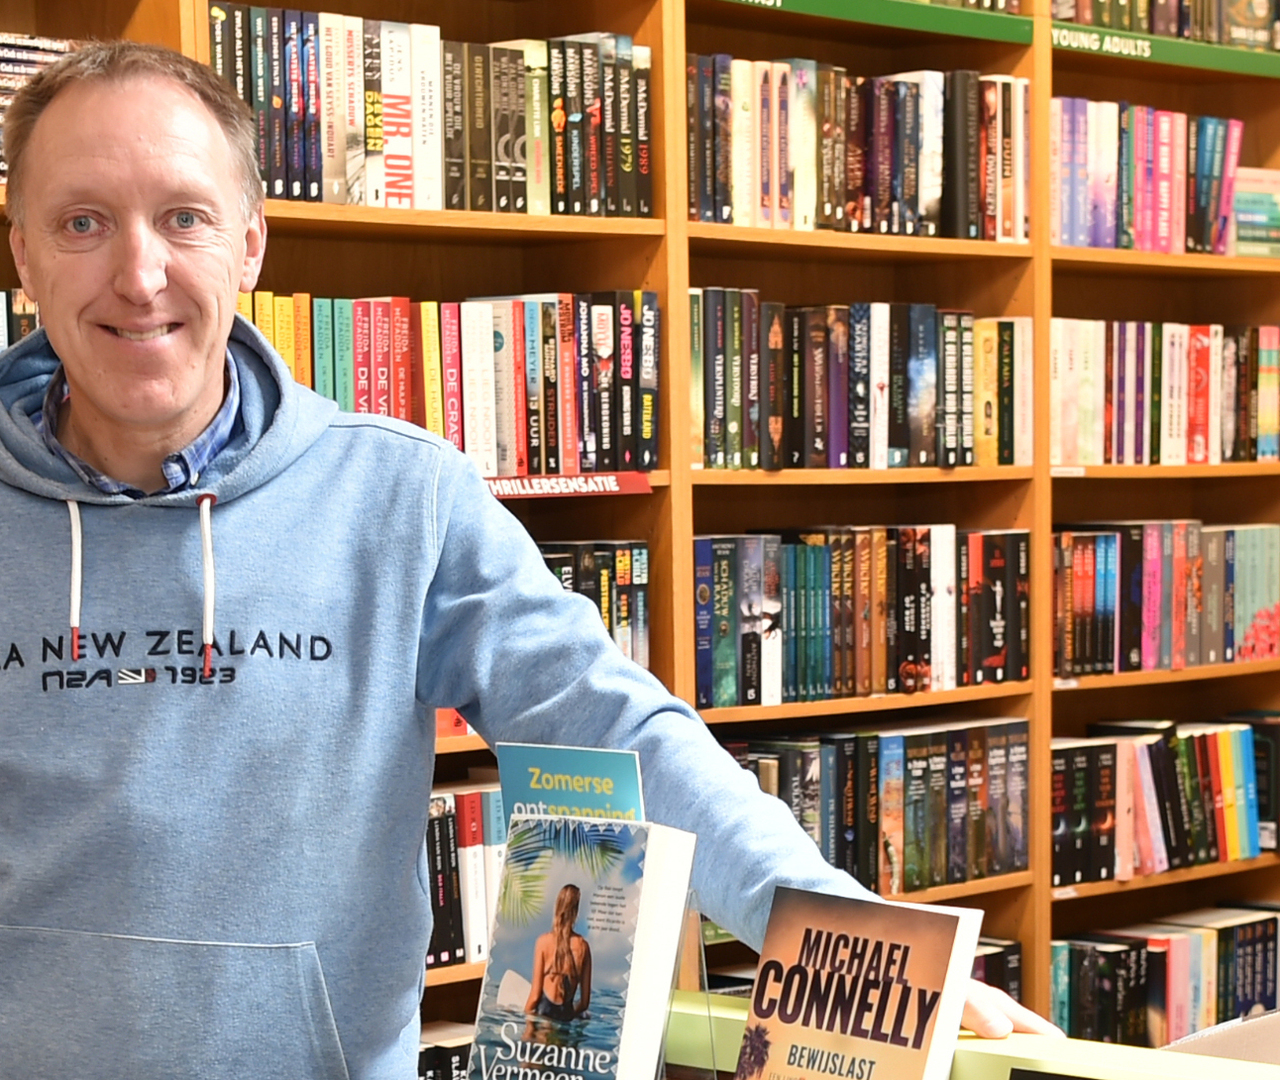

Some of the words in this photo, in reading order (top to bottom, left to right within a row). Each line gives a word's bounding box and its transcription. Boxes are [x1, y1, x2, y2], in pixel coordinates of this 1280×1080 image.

[1051, 28, 1101, 52] YOUNG
[1103, 36, 1151, 58] ADULTS
[383, 94, 411, 144] MR.
[639, 143, 648, 174] 1989
[385, 156, 411, 210] ONE
[42, 631, 126, 663] NEW
[146, 629, 333, 661] ZEALAND
[529, 768, 614, 796] Zomerse
[798, 928, 910, 986] MICHAEL
[753, 960, 940, 1050] CONNELLY
[500, 1021, 611, 1075] Suzanne
[769, 1073, 780, 1080] EEN
